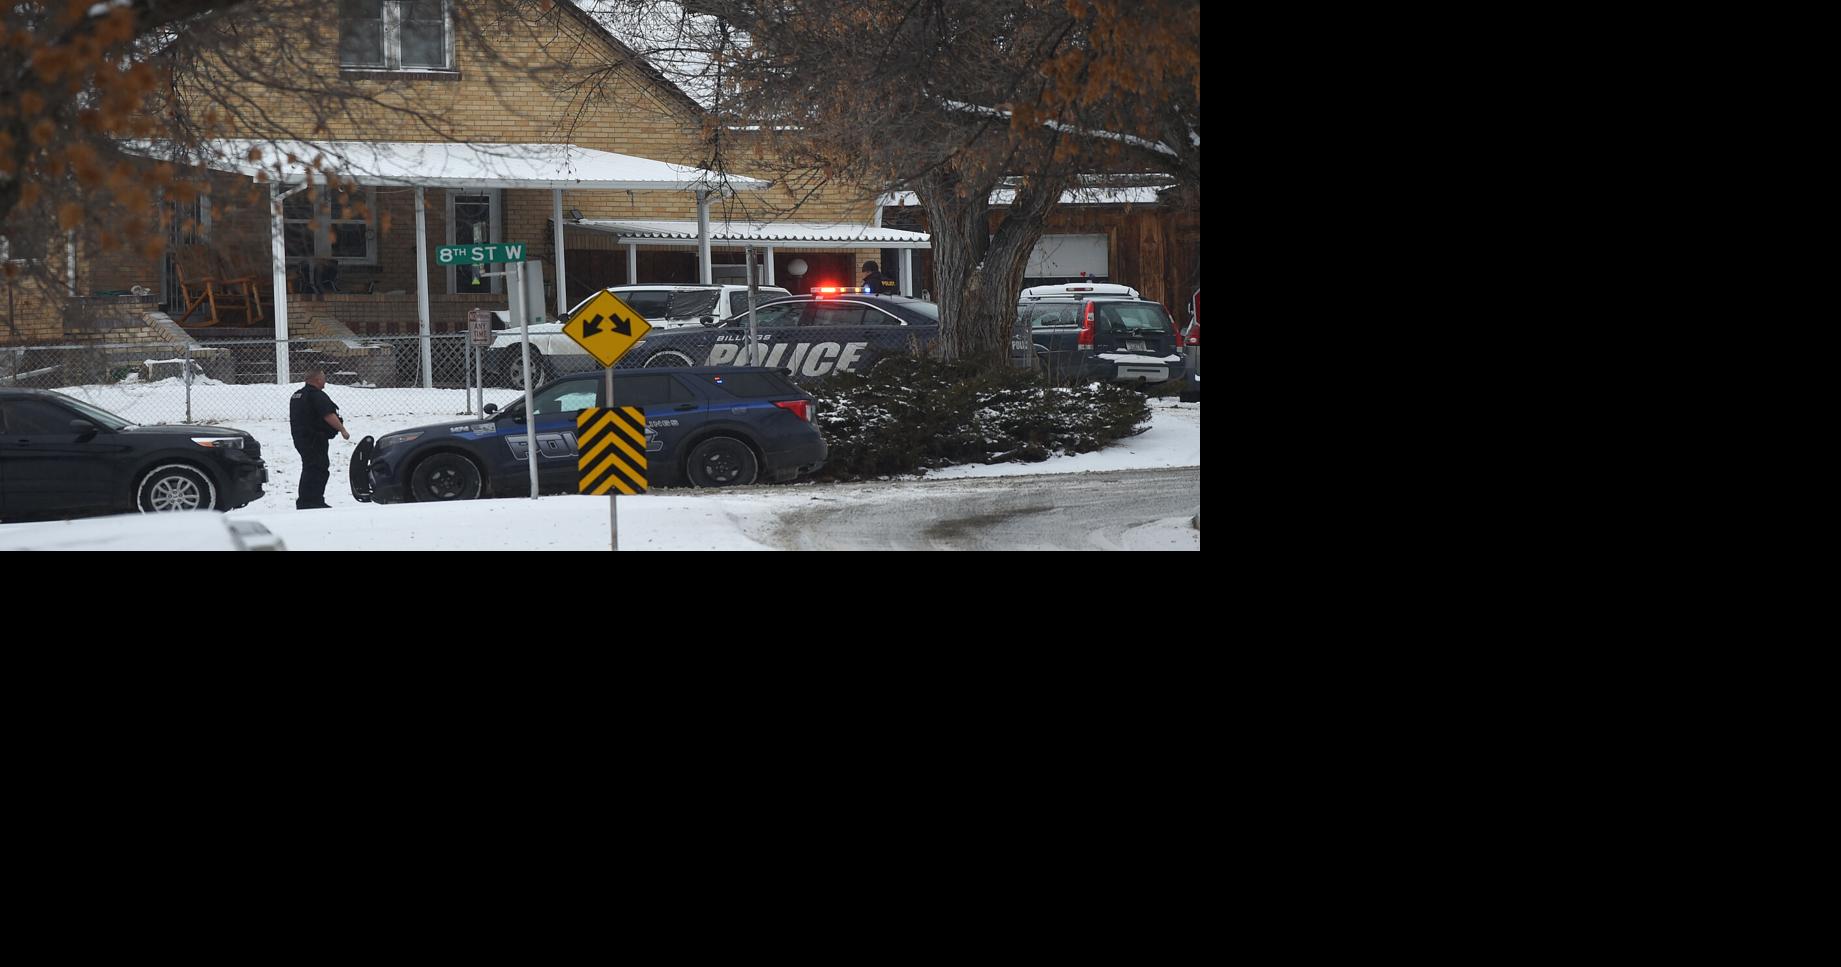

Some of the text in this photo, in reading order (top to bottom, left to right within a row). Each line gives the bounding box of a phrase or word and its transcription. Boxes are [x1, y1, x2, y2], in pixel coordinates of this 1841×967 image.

[440, 245, 521, 262] 8TH ST W
[703, 341, 868, 377] POLICE
